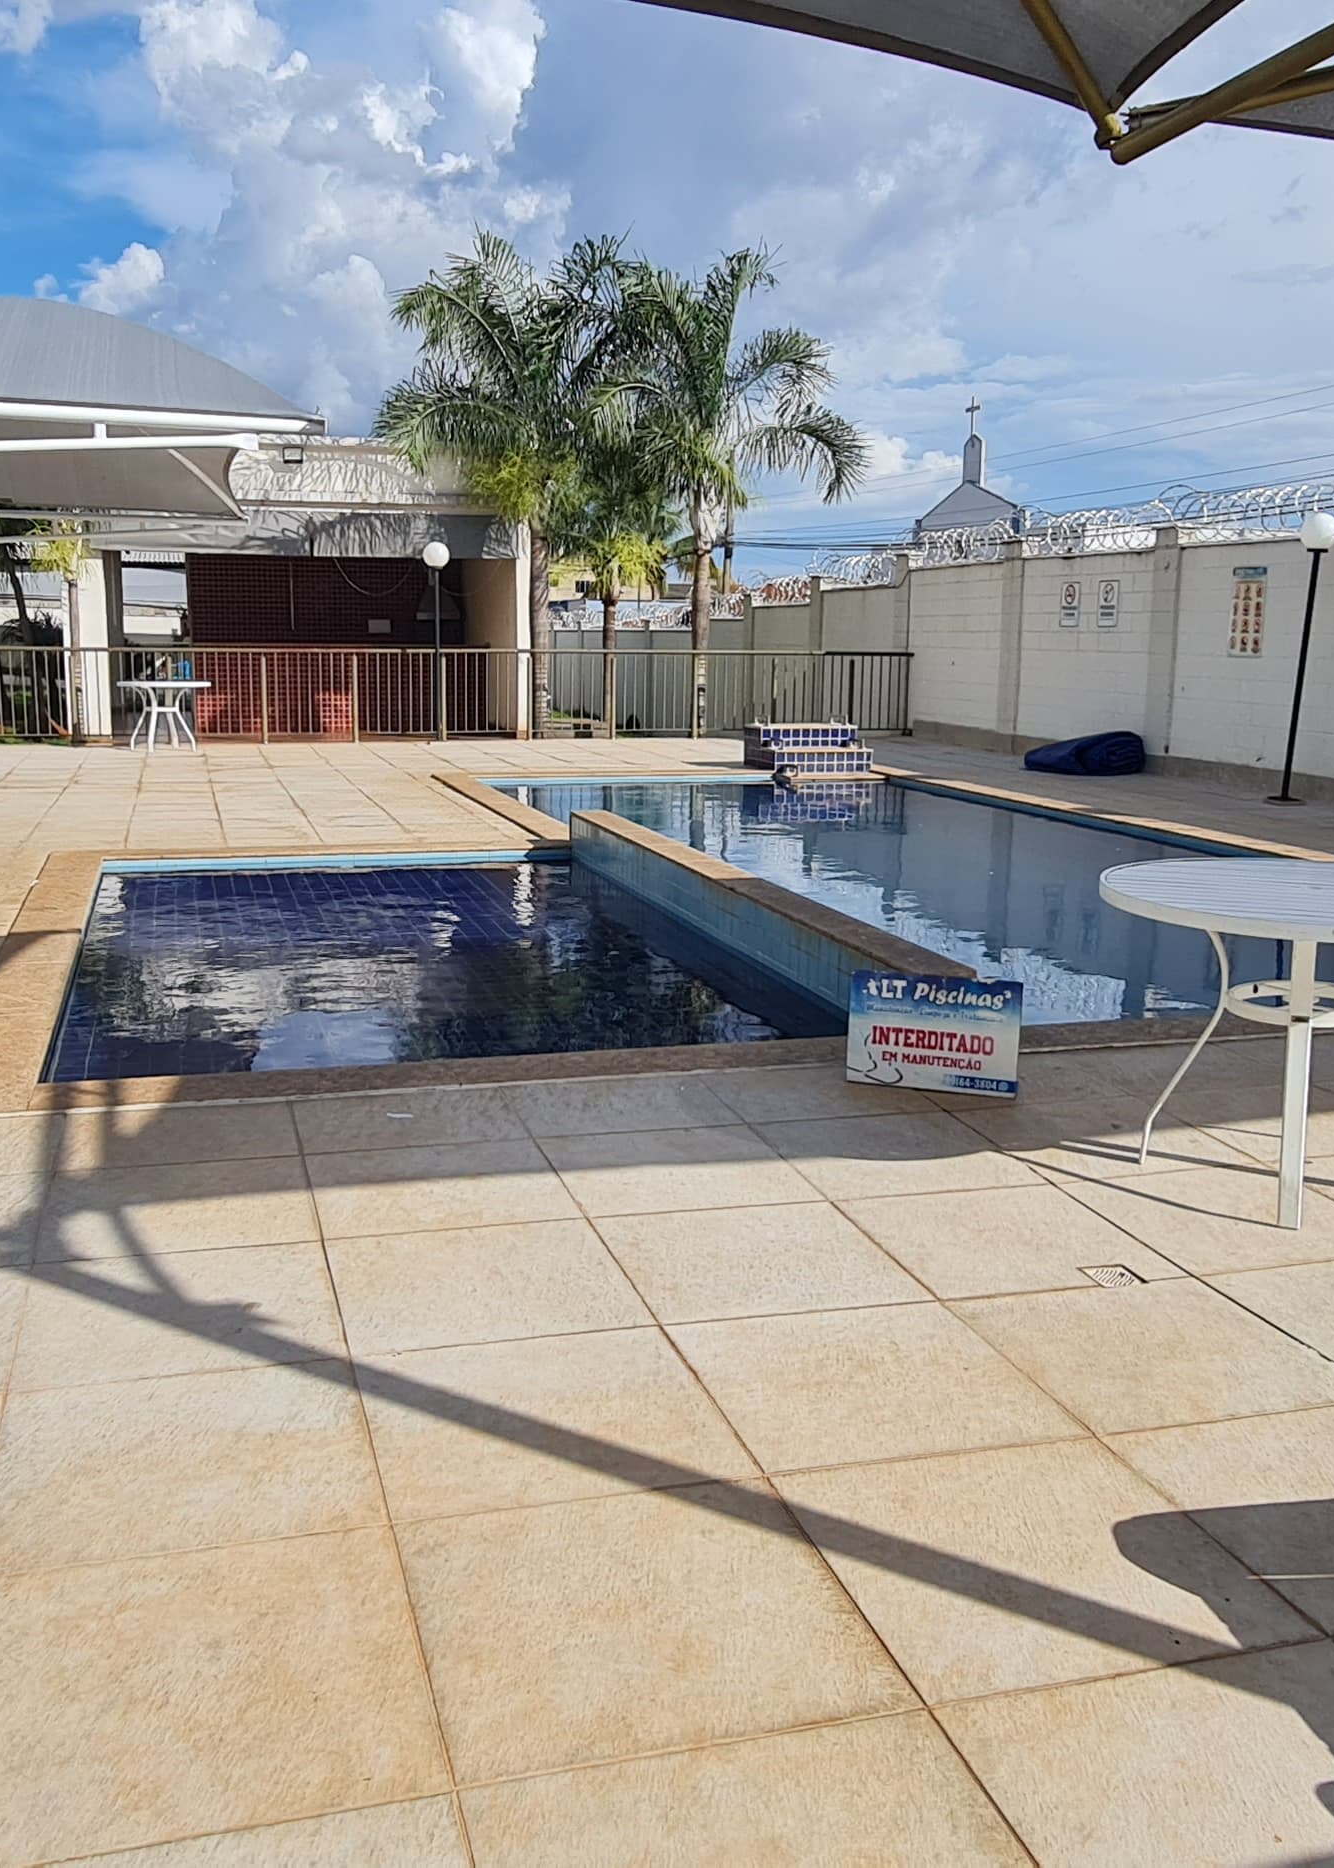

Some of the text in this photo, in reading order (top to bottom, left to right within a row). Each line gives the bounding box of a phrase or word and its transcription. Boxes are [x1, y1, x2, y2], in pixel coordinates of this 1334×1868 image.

[871, 1025, 995, 1056] INTERDITADO
[881, 1051, 982, 1071] EM MANUTENÇÃO
